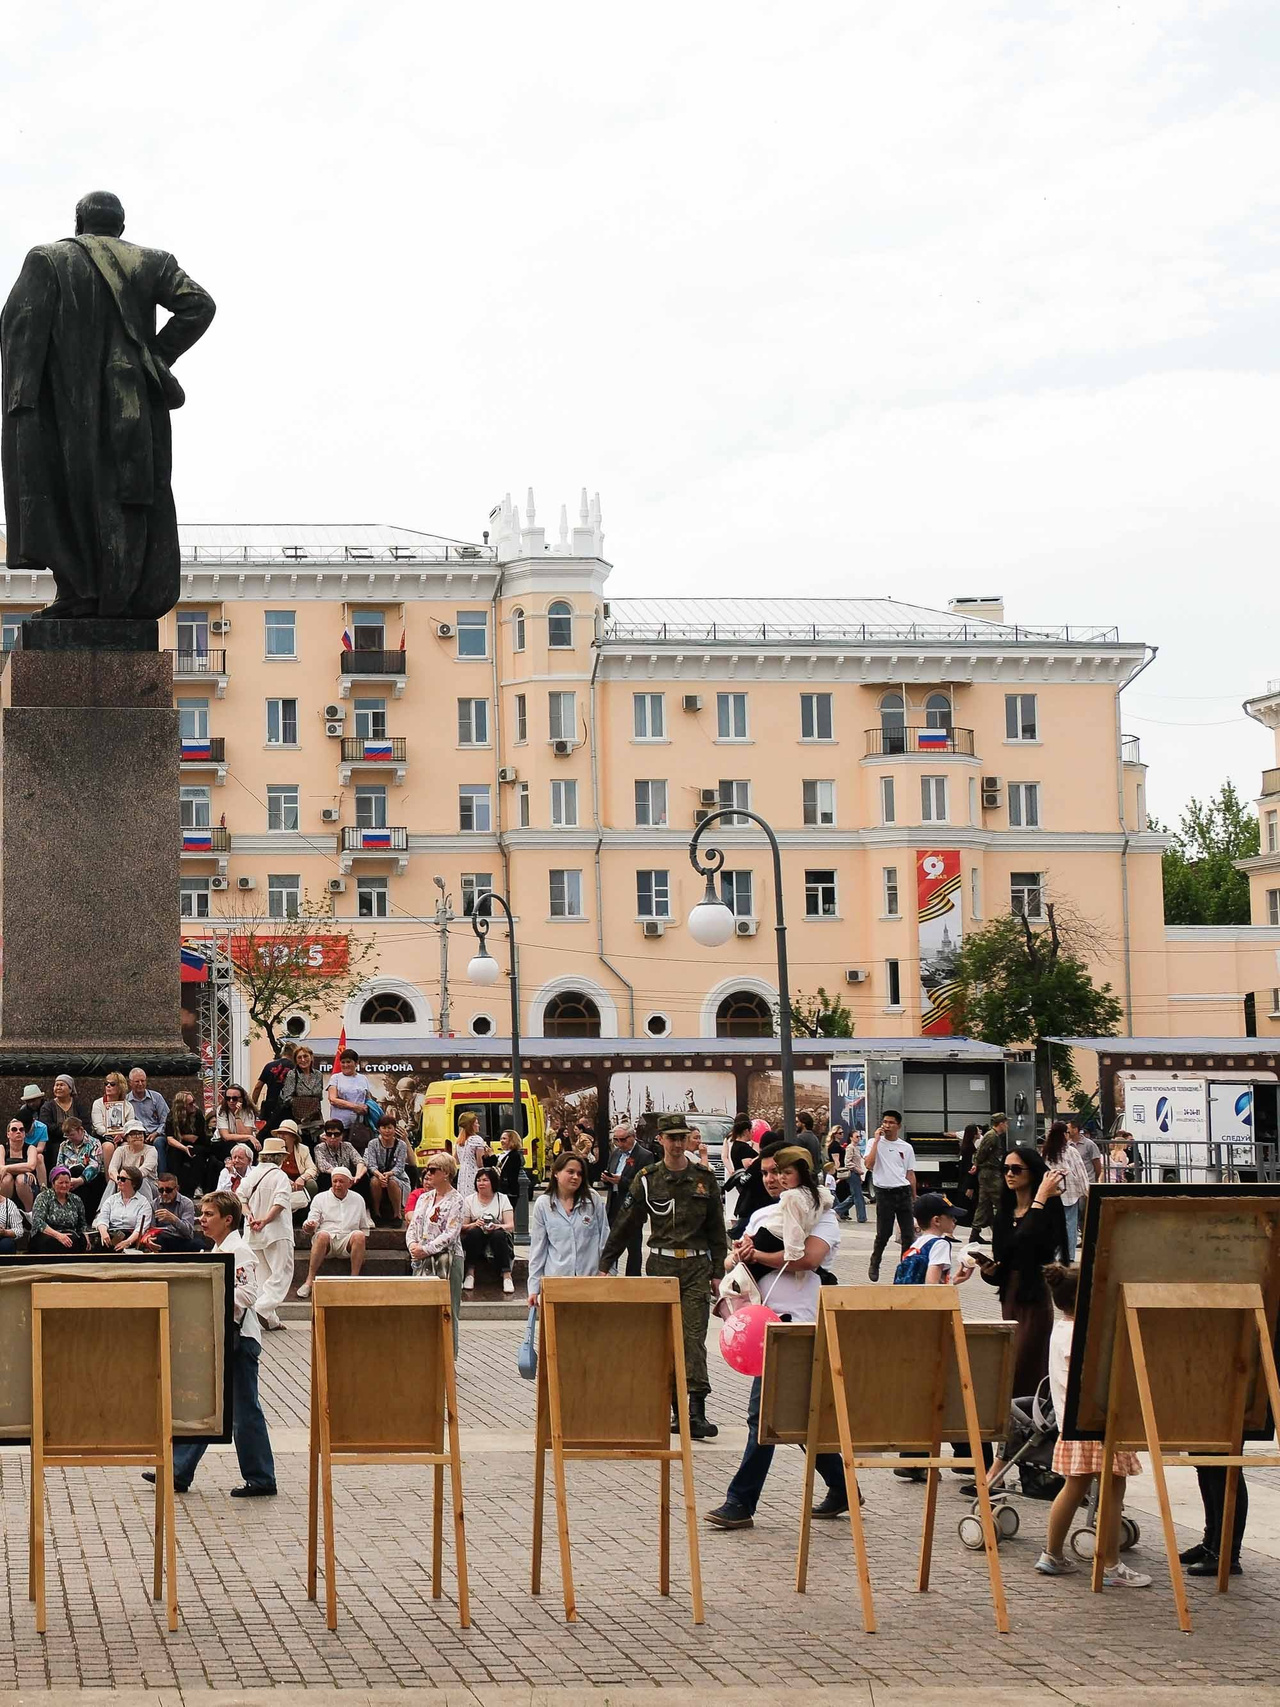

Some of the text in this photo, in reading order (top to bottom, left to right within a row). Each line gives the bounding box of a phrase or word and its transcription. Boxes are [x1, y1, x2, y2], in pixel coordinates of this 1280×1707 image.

[923, 856, 945, 879] 9
[365, 1064, 413, 1072] СТОРОНА
[836, 1079, 849, 1097] 100
